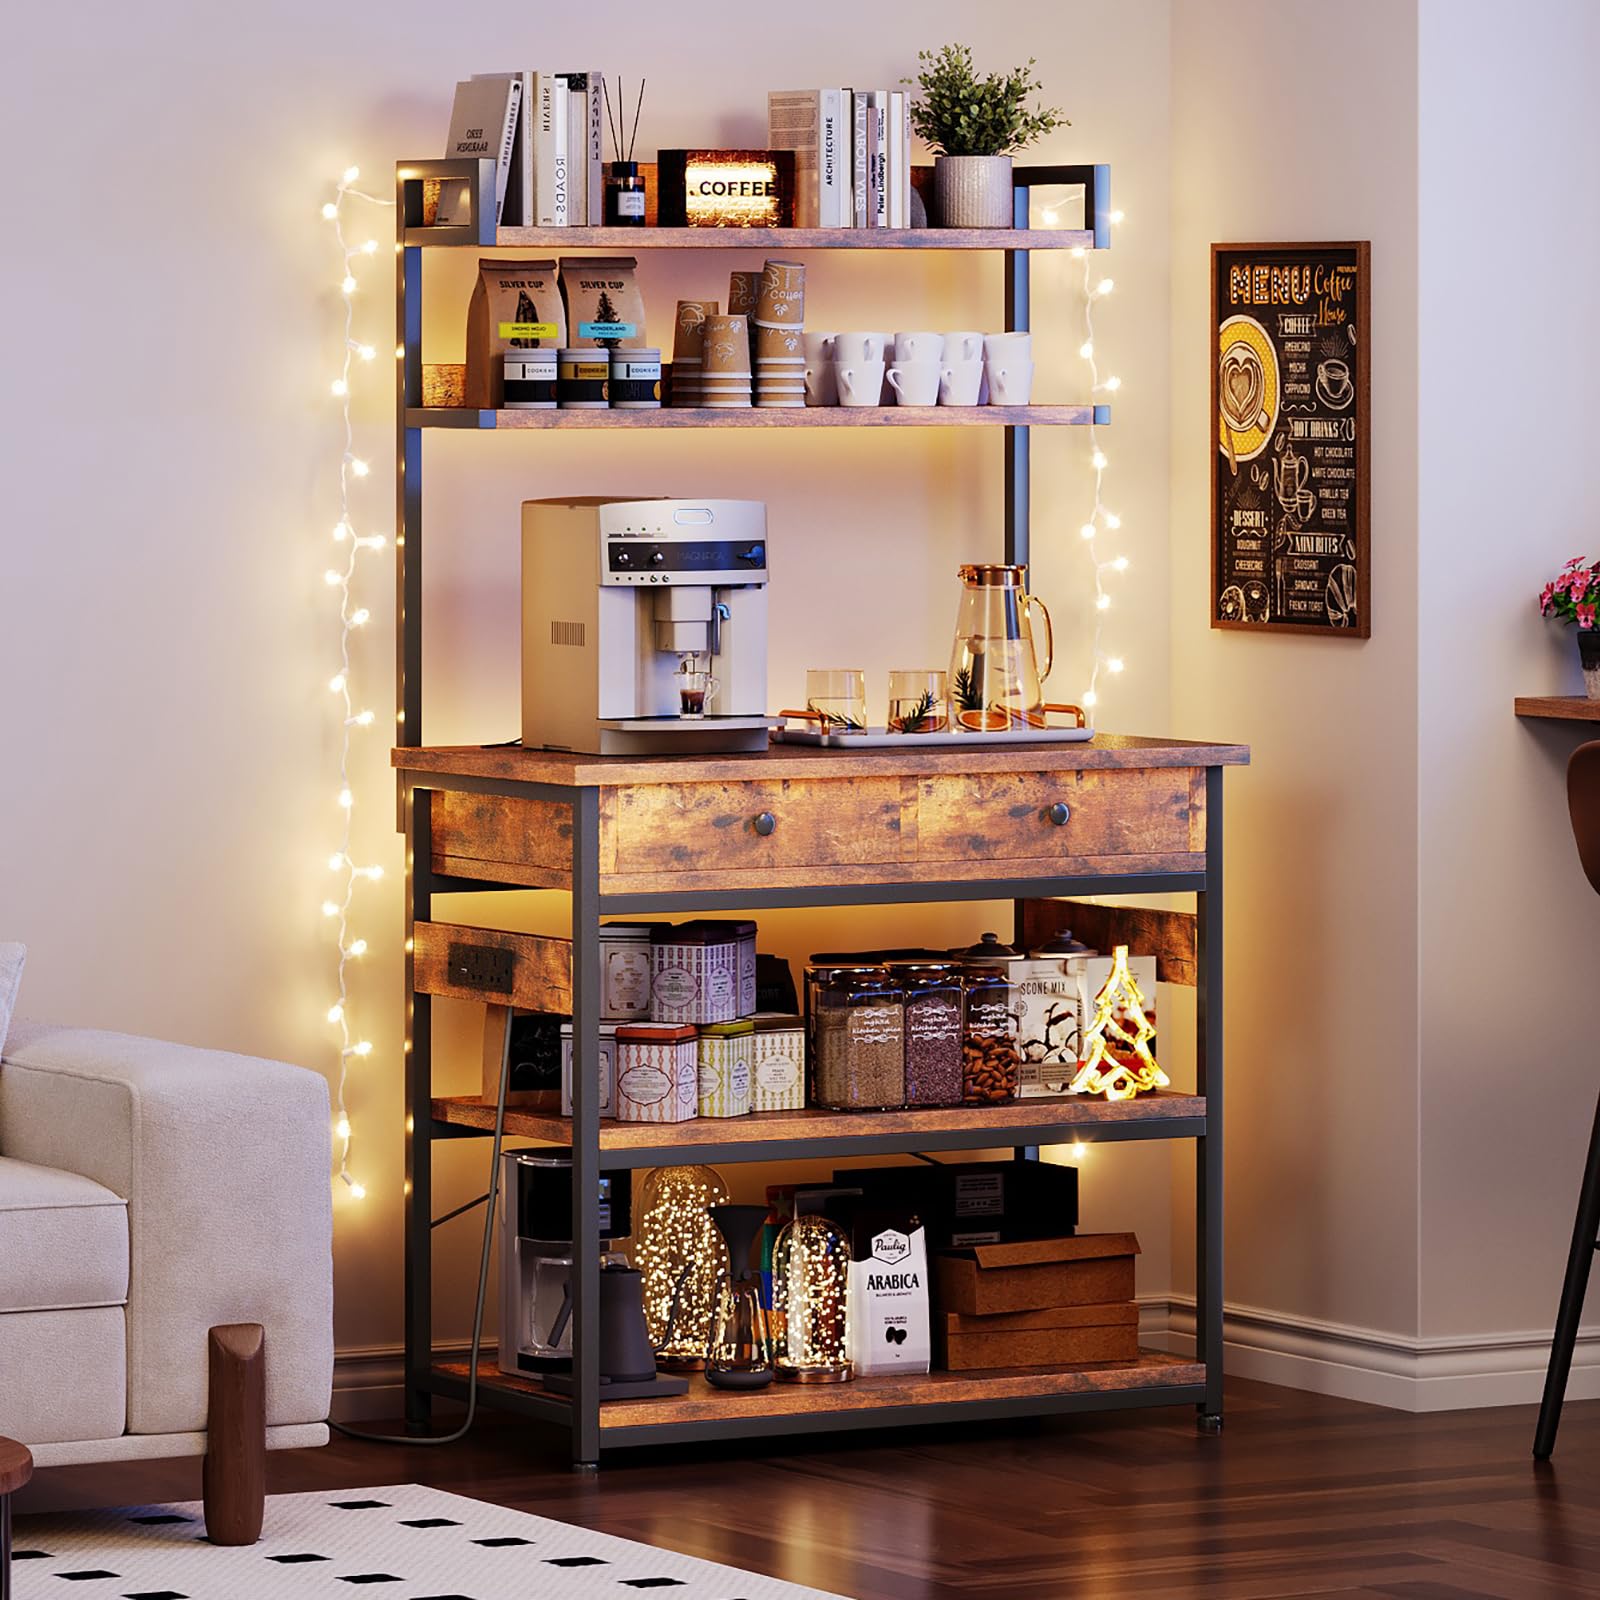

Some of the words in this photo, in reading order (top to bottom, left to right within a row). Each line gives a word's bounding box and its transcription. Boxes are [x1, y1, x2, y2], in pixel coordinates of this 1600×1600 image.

[855, 127, 867, 173] ABOUT
[877, 152, 886, 192] Lindbergh
[699, 181, 776, 197] COFFEE
[877, 193, 885, 214] Peter
[499, 280, 526, 289] SILVER
[528, 280, 544, 289] CUP
[580, 280, 607, 289] SILVER
[608, 280, 625, 289] CUP
[1230, 265, 1311, 305] MENU
[1314, 265, 1354, 303] Coffee
[1319, 297, 1348, 326] House
[1284, 316, 1311, 334] COFFEE
[1288, 362, 1306, 373] MOCHA
[1294, 421, 1309, 437] HOT
[1310, 421, 1339, 438] DRINKS
[1314, 447, 1325, 458] HOT
[1325, 447, 1354, 458] CHOCOLATE
[1312, 468, 1327, 478] WHITE
[1327, 468, 1355, 479] CHOCOLATE
[1233, 510, 1265, 527] DESSERT
[1321, 508, 1336, 519] GREEN
[1295, 536, 1314, 553] MINI
[1315, 537, 1338, 553] BITES
[1294, 580, 1319, 591] SANDWICH
[1289, 599, 1308, 611] FRENCH
[1308, 600, 1324, 612] TOAST
[1020, 981, 1047, 996] SCONE
[1051, 981, 1066, 993] MIX
[875, 1238, 906, 1255] Paulig
[866, 1273, 920, 1291] ARABICA
